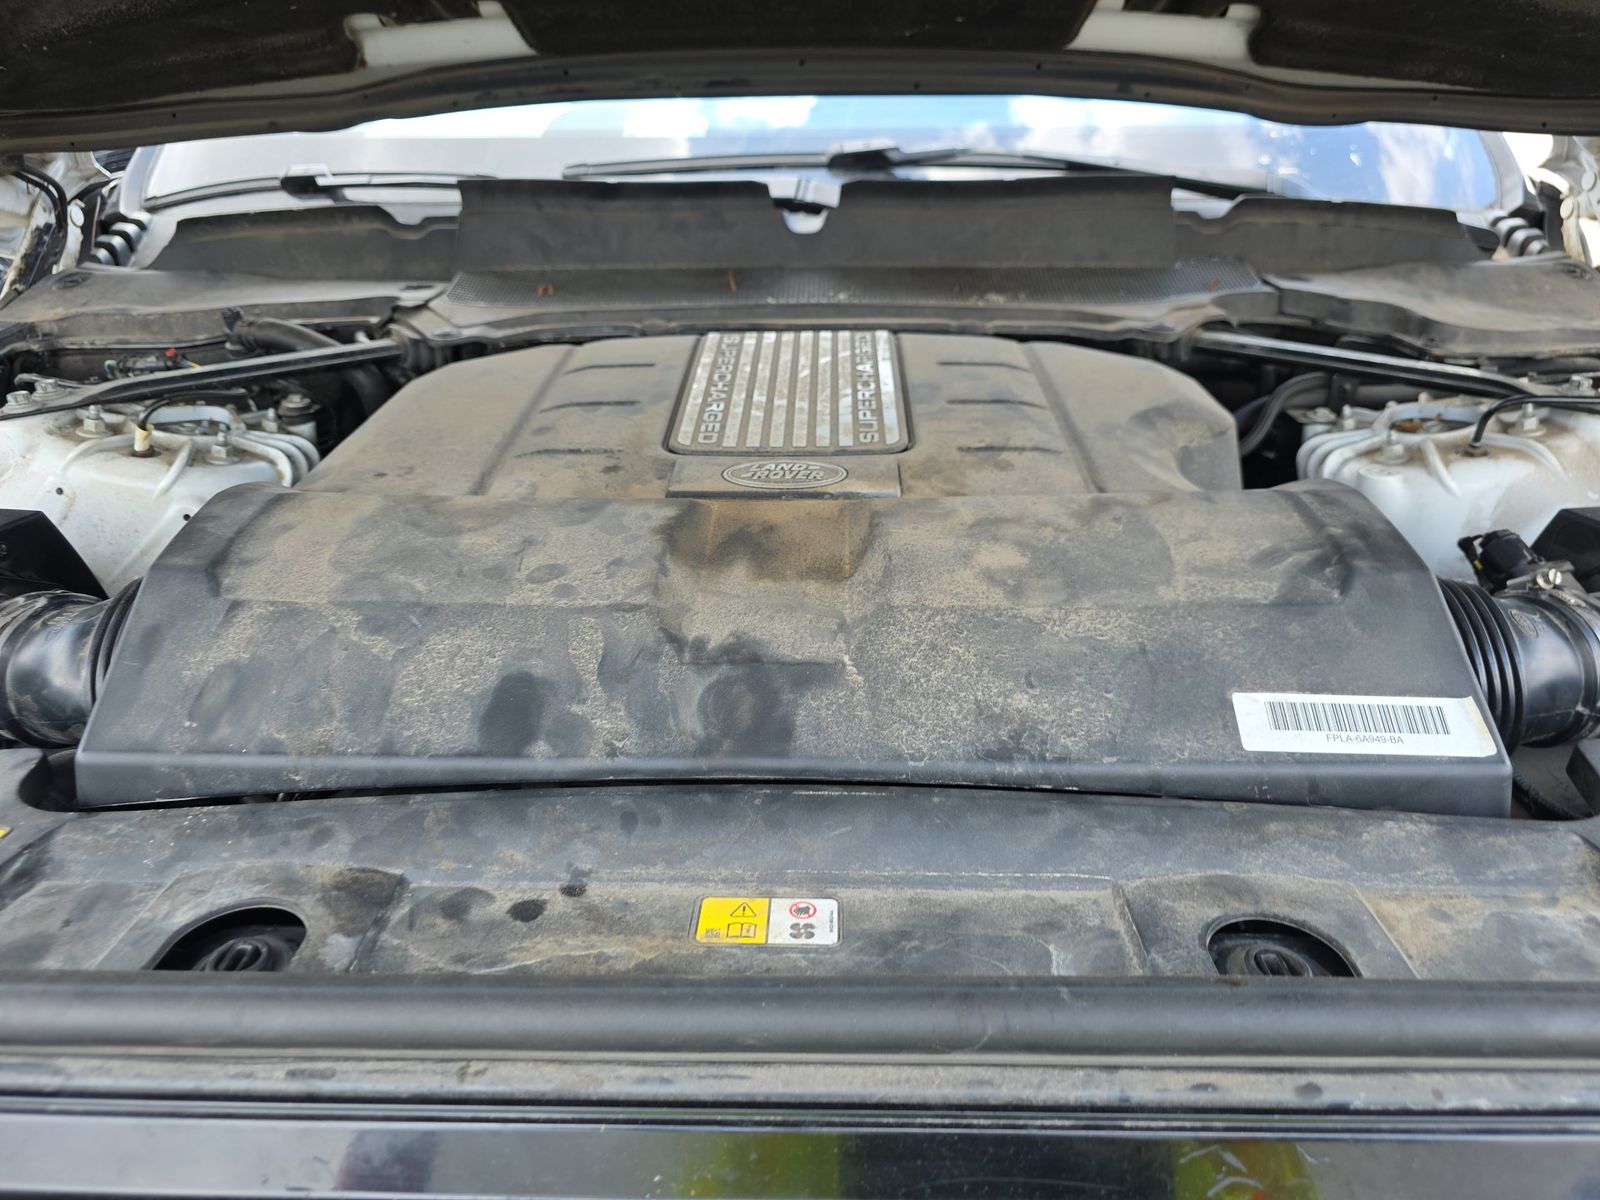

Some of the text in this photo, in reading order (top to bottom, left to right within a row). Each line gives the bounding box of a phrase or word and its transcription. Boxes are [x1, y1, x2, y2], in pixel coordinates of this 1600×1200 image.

[698, 334, 740, 444] SUPERCHARGED
[752, 470, 825, 480] ROVER
[1326, 733, 1405, 744] FPLA-6A949-BA
